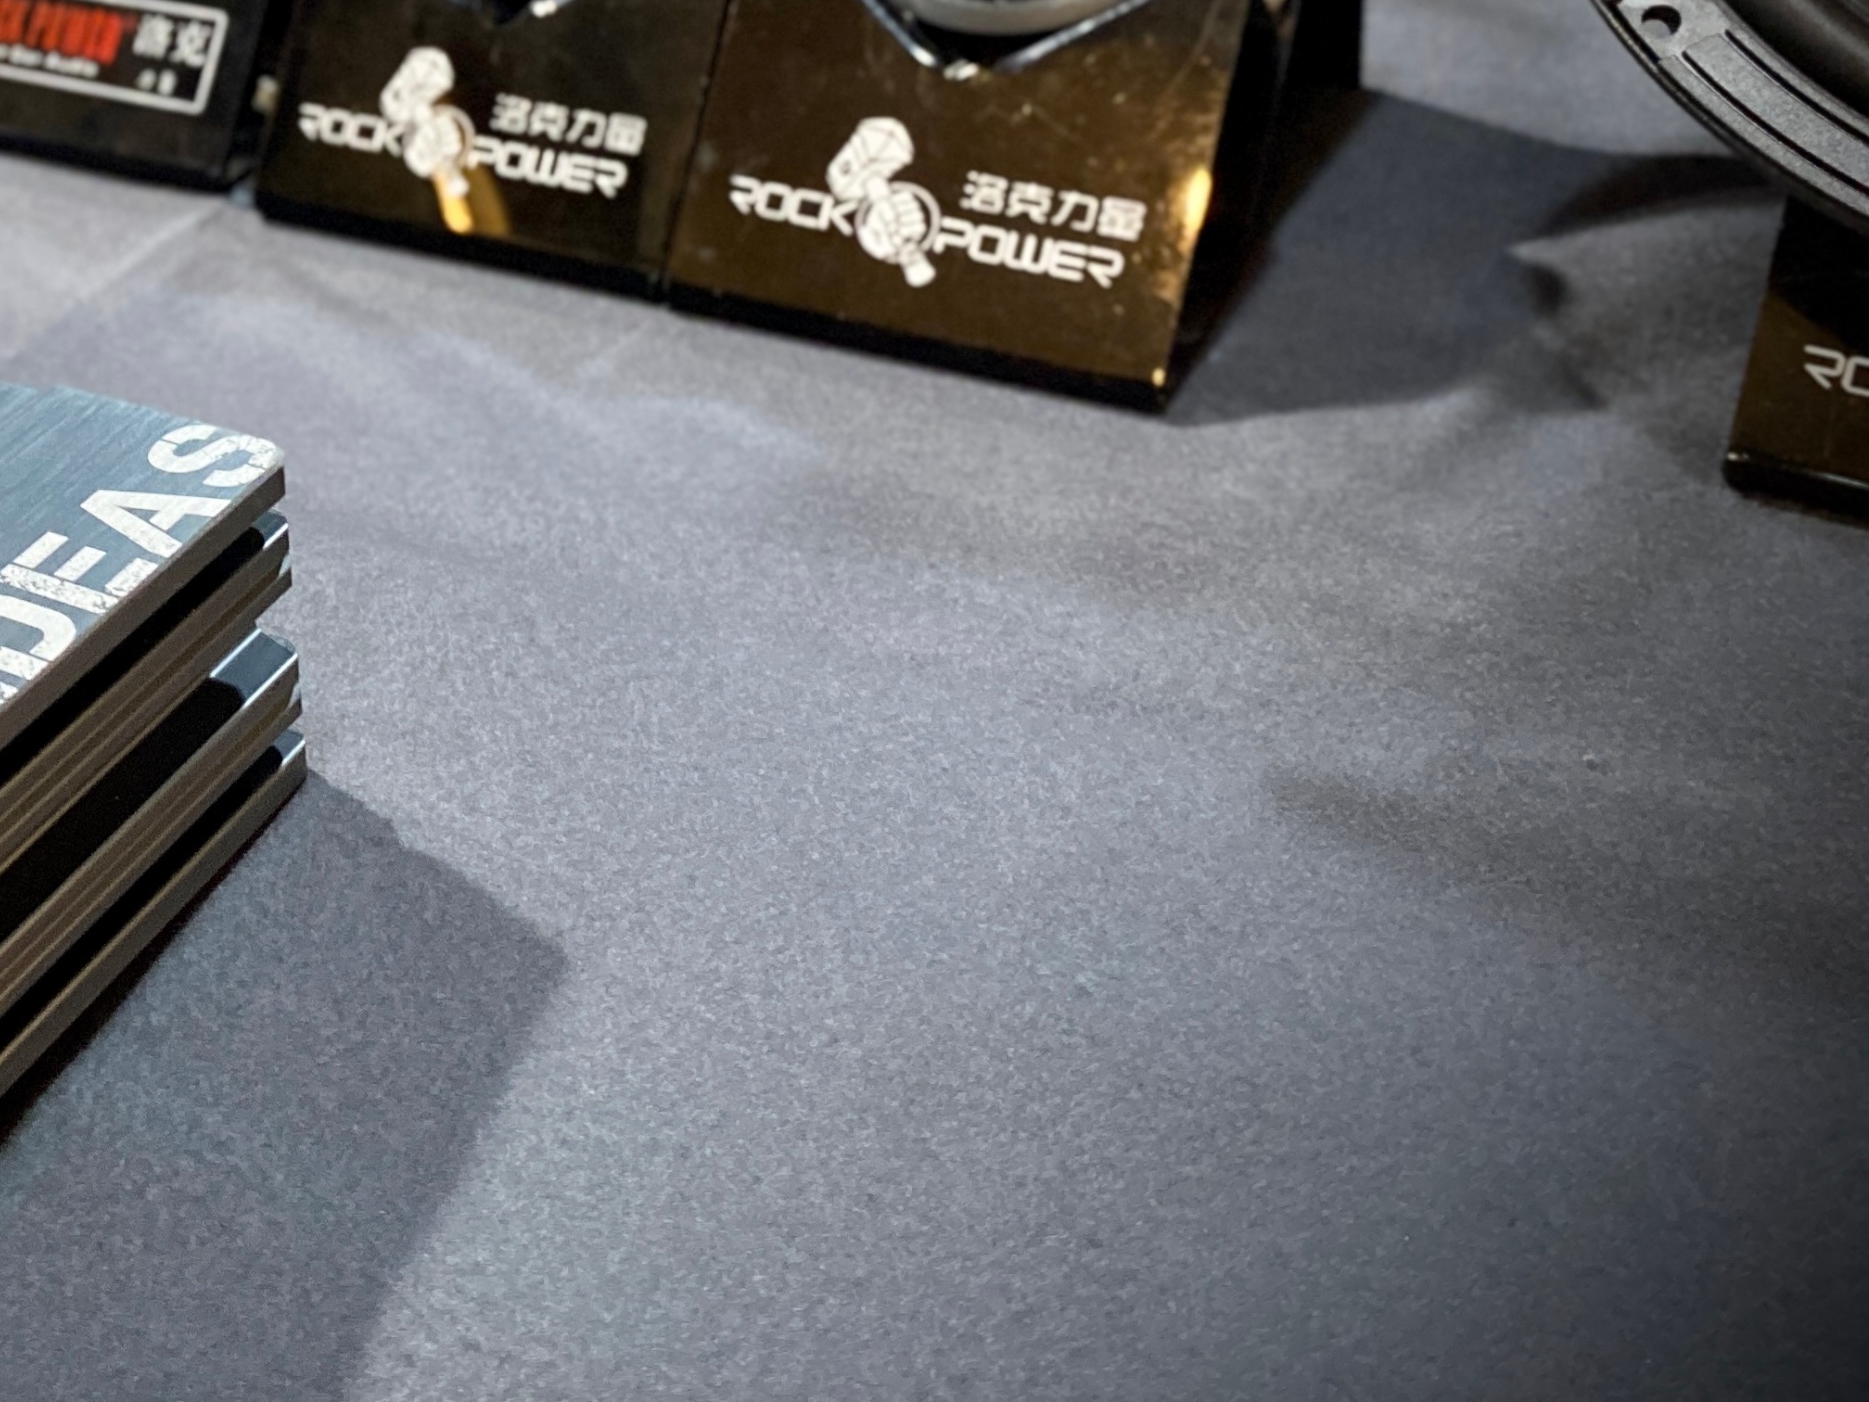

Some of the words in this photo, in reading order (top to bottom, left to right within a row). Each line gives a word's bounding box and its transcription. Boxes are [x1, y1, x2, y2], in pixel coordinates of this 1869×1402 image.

[298, 102, 406, 157] ROCK
[467, 134, 628, 198] POWER
[730, 174, 857, 236] ROCK
[933, 216, 1125, 288] POWER
